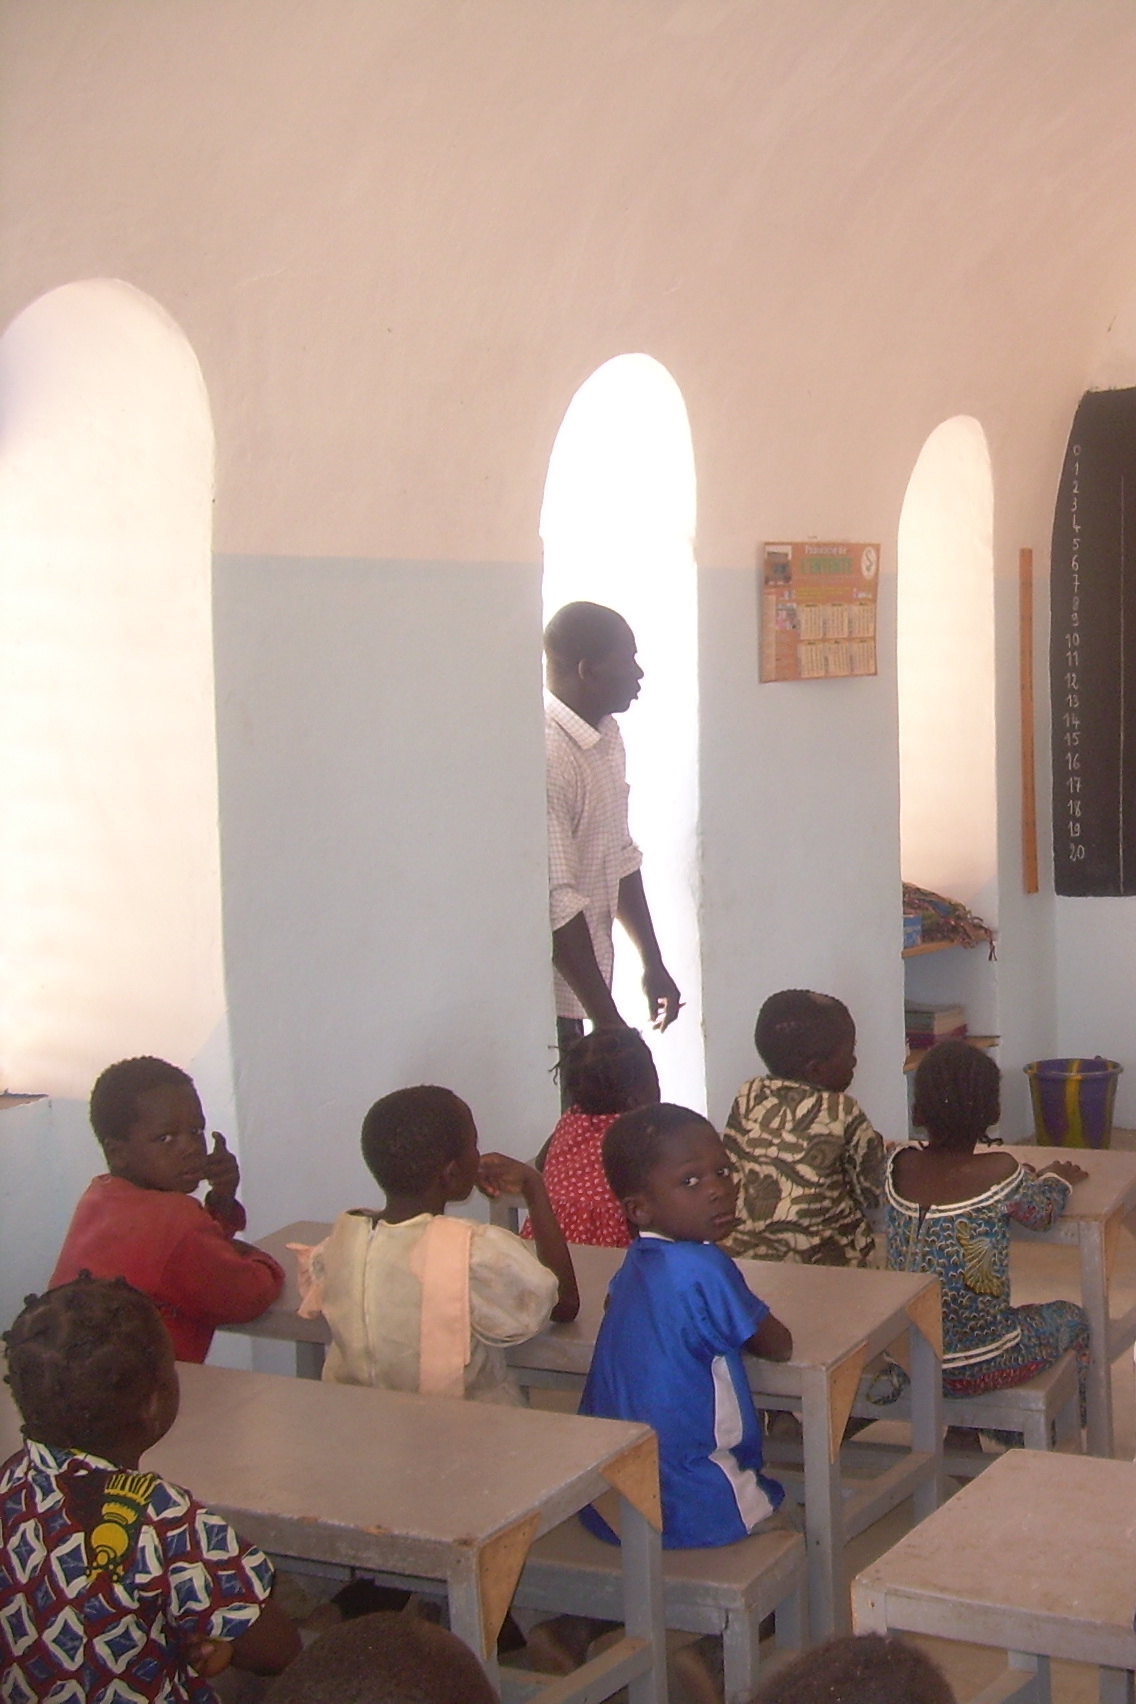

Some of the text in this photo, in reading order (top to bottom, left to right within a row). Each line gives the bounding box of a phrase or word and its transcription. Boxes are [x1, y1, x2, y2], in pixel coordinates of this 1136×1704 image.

[1073, 462, 1079, 476] 1
[1072, 480, 1079, 494] 2
[1070, 498, 1078, 512] 3
[1072, 514, 1081, 533] 4
[1072, 538, 1080, 551] 5
[1071, 554, 1079, 571] 6
[1072, 574, 1080, 593] 7
[1071, 612, 1079, 627] 9
[1065, 633, 1080, 648] 10
[1066, 651, 1079, 667] 11
[1065, 673, 1079, 690] 12
[1066, 694, 1080, 709] 13
[1063, 713, 1080, 729] 14
[1065, 732, 1081, 746] 15
[1066, 752, 1081, 771] 16
[1067, 776, 1081, 794] 17
[1067, 800, 1082, 817] 18
[1068, 820, 1081, 837] 19
[1069, 844, 1085, 861] 20
